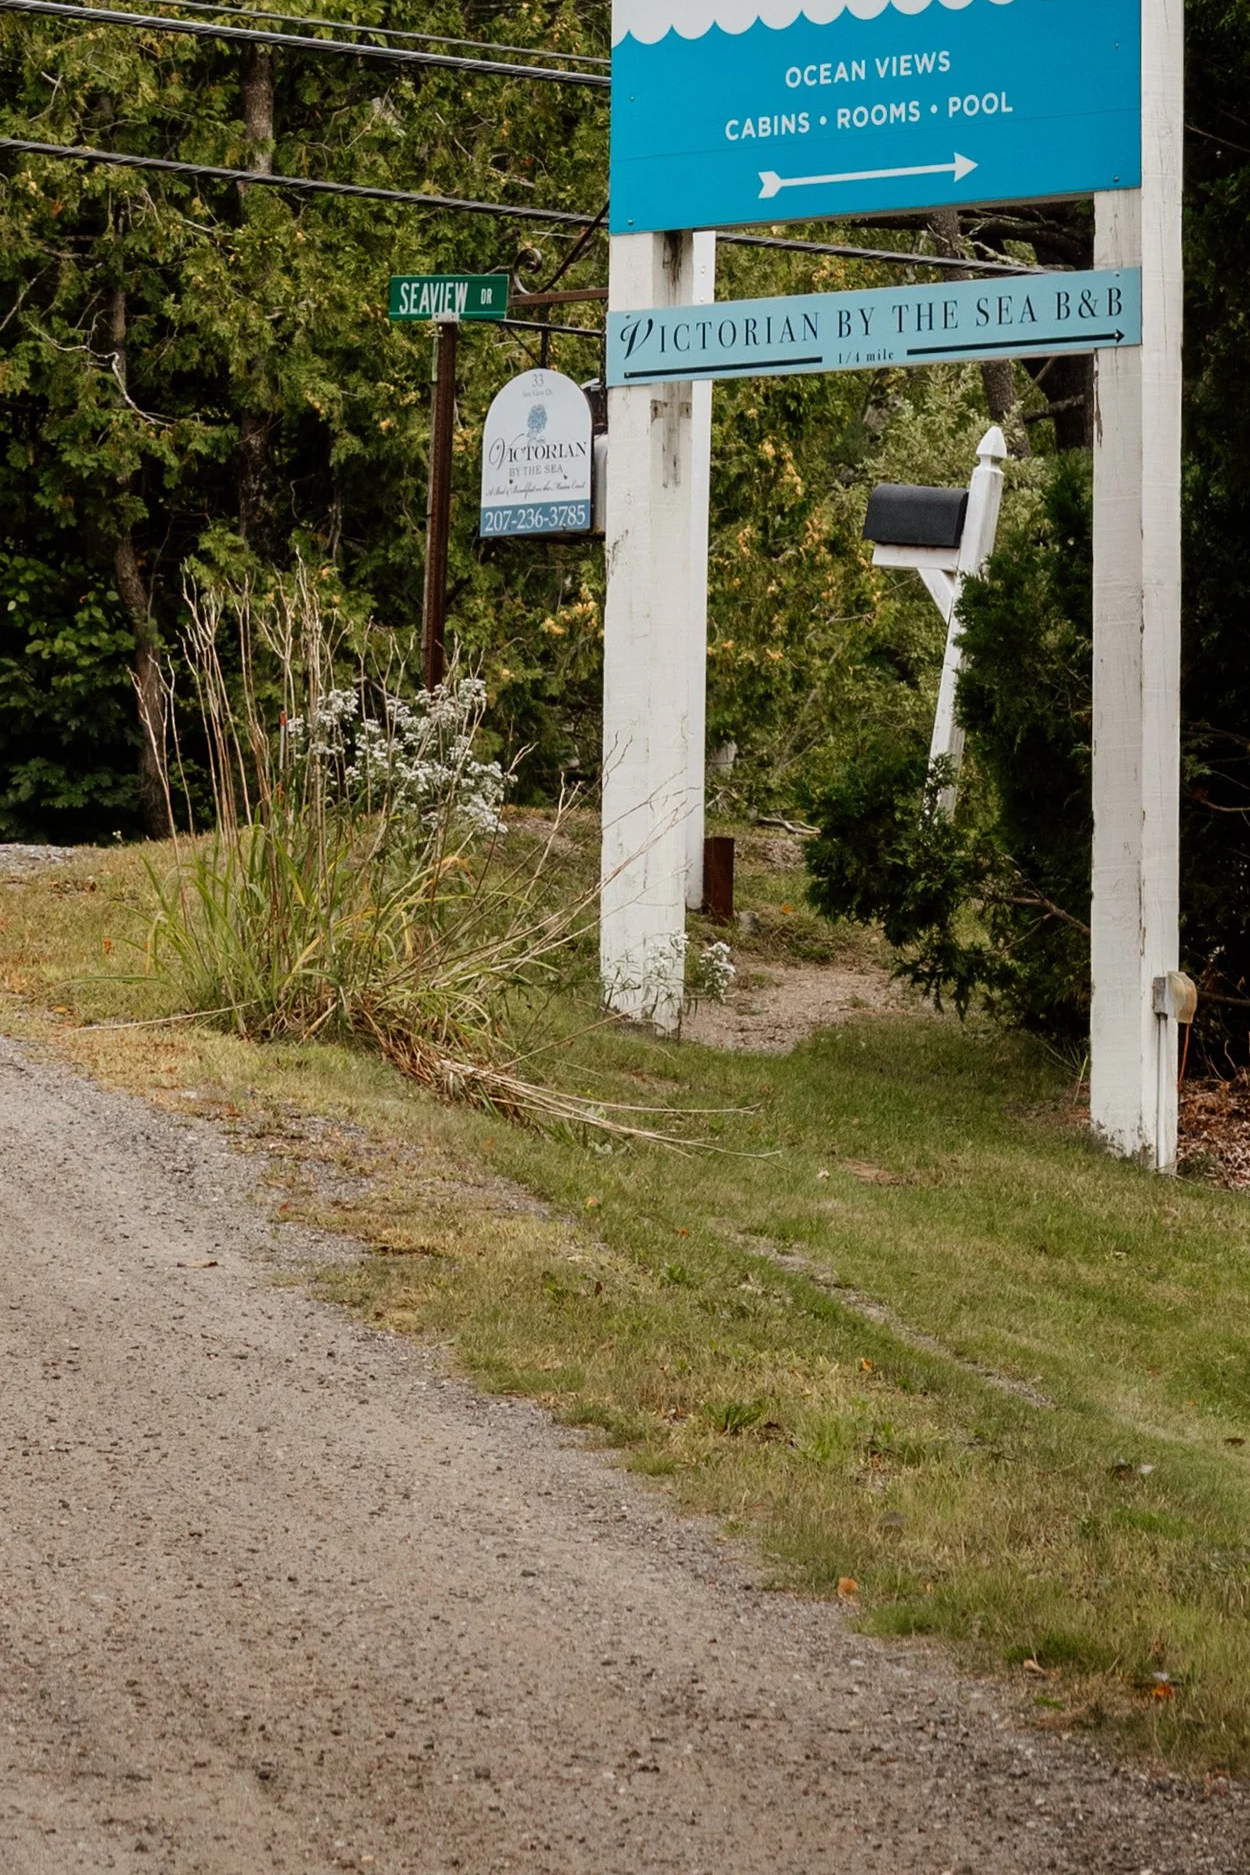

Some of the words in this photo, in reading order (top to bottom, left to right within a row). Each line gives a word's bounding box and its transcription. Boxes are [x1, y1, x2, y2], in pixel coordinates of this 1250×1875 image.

[785, 59, 866, 89] OCEAN
[874, 50, 951, 80] VIEWS
[725, 112, 811, 141] CABINS
[837, 101, 921, 130] ROOMS
[948, 91, 1013, 118] POOL
[399, 282, 468, 315] SEAVIEW
[481, 288, 493, 305] DR
[620, 312, 819, 361] VICTORIAN
[837, 307, 875, 338] BY
[892, 300, 959, 333] THE
[976, 295, 1037, 327] SEA
[1055, 286, 1123, 320] B&B
[838, 351, 860, 364] 1/4
[866, 348, 894, 362] mile
[532, 373, 544, 388] 33
[489, 433, 586, 470] VICTORIAN
[509, 466, 520, 477] BY
[523, 465, 541, 476] THE
[544, 463, 563, 474] SEA
[485, 505, 586, 531] 207-236-3785
